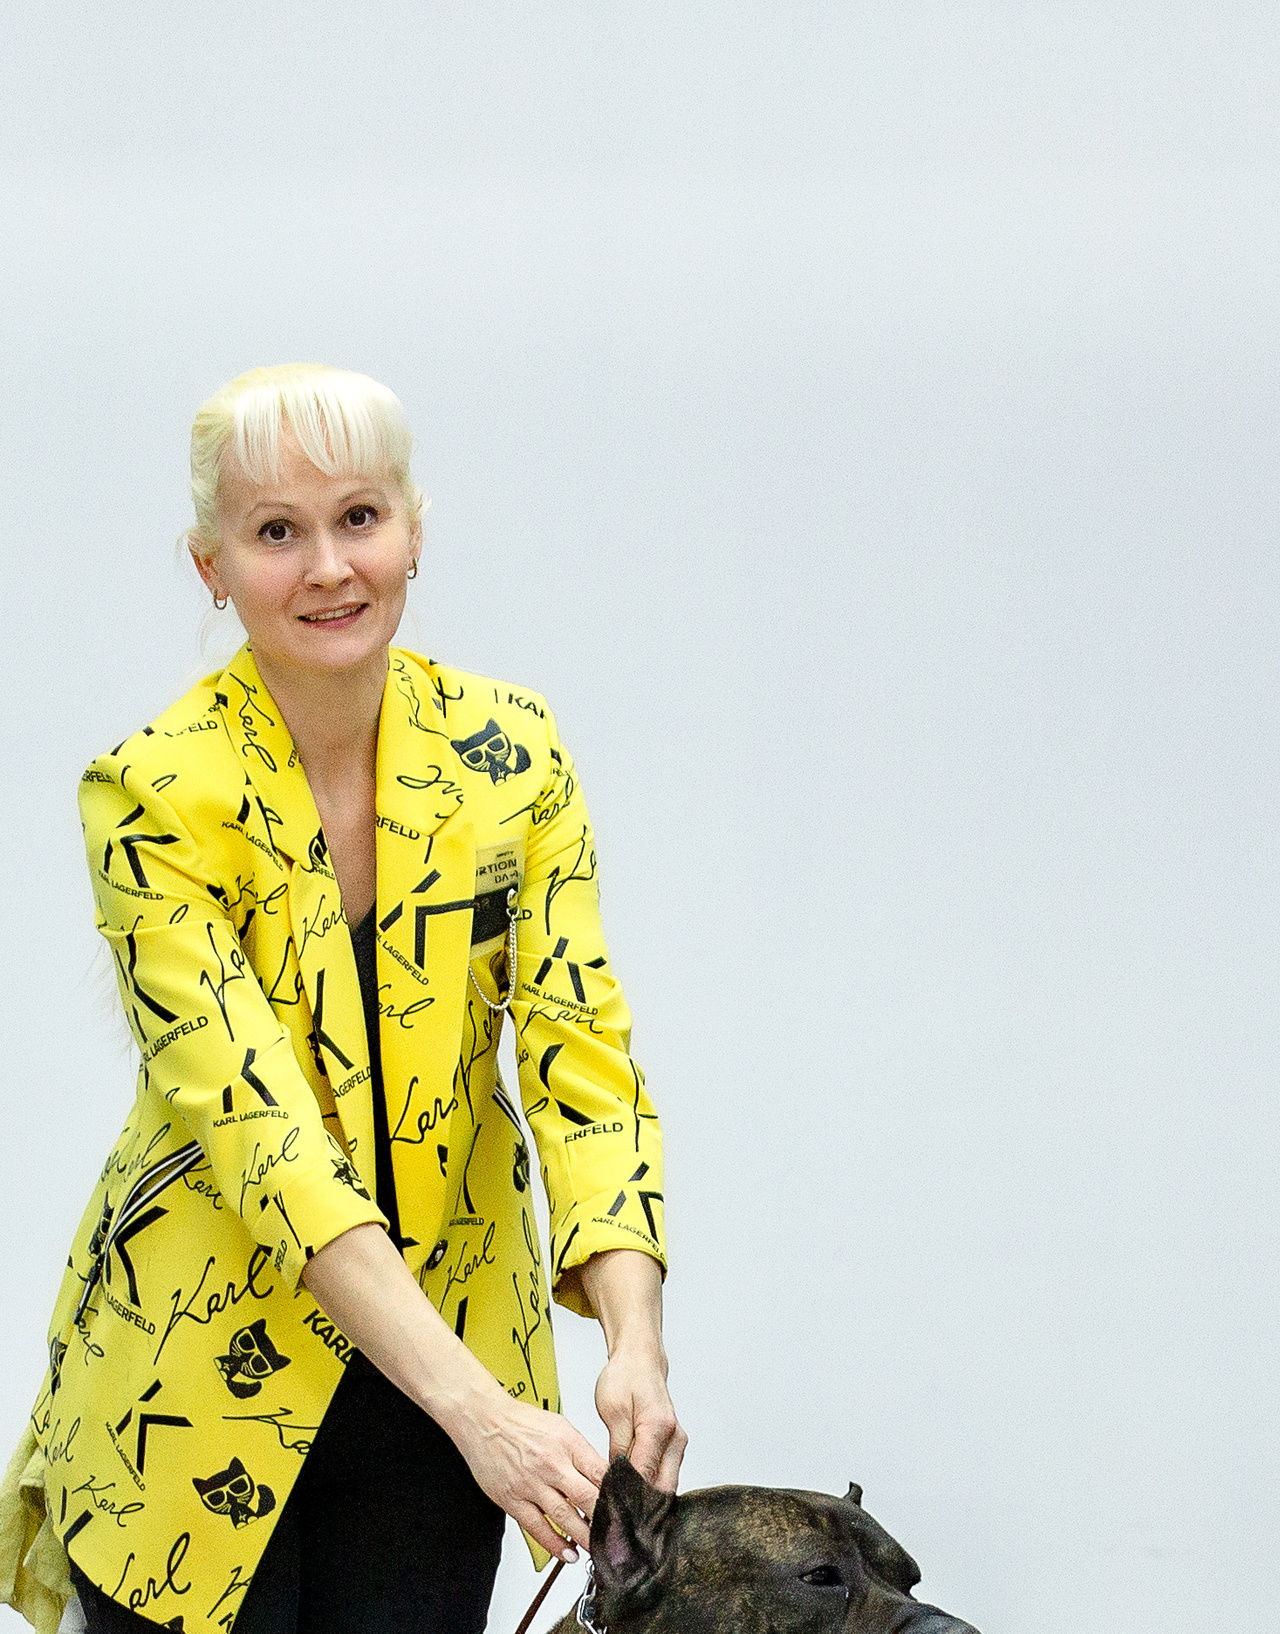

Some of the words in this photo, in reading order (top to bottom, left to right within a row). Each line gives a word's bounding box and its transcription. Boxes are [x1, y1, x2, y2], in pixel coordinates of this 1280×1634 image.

[382, 940, 429, 986] LAGERFELD
[543, 989, 599, 1016] LAGERFELD
[151, 1015, 209, 1057] LAGERFELD
[213, 1115, 239, 1128] KARL
[239, 1109, 289, 1122] LAGERFELD
[240, 1127, 299, 1218] Karl
[439, 1221, 495, 1314] Karl
[153, 1245, 274, 1366] Karl
[71, 1475, 145, 1527] Karl
